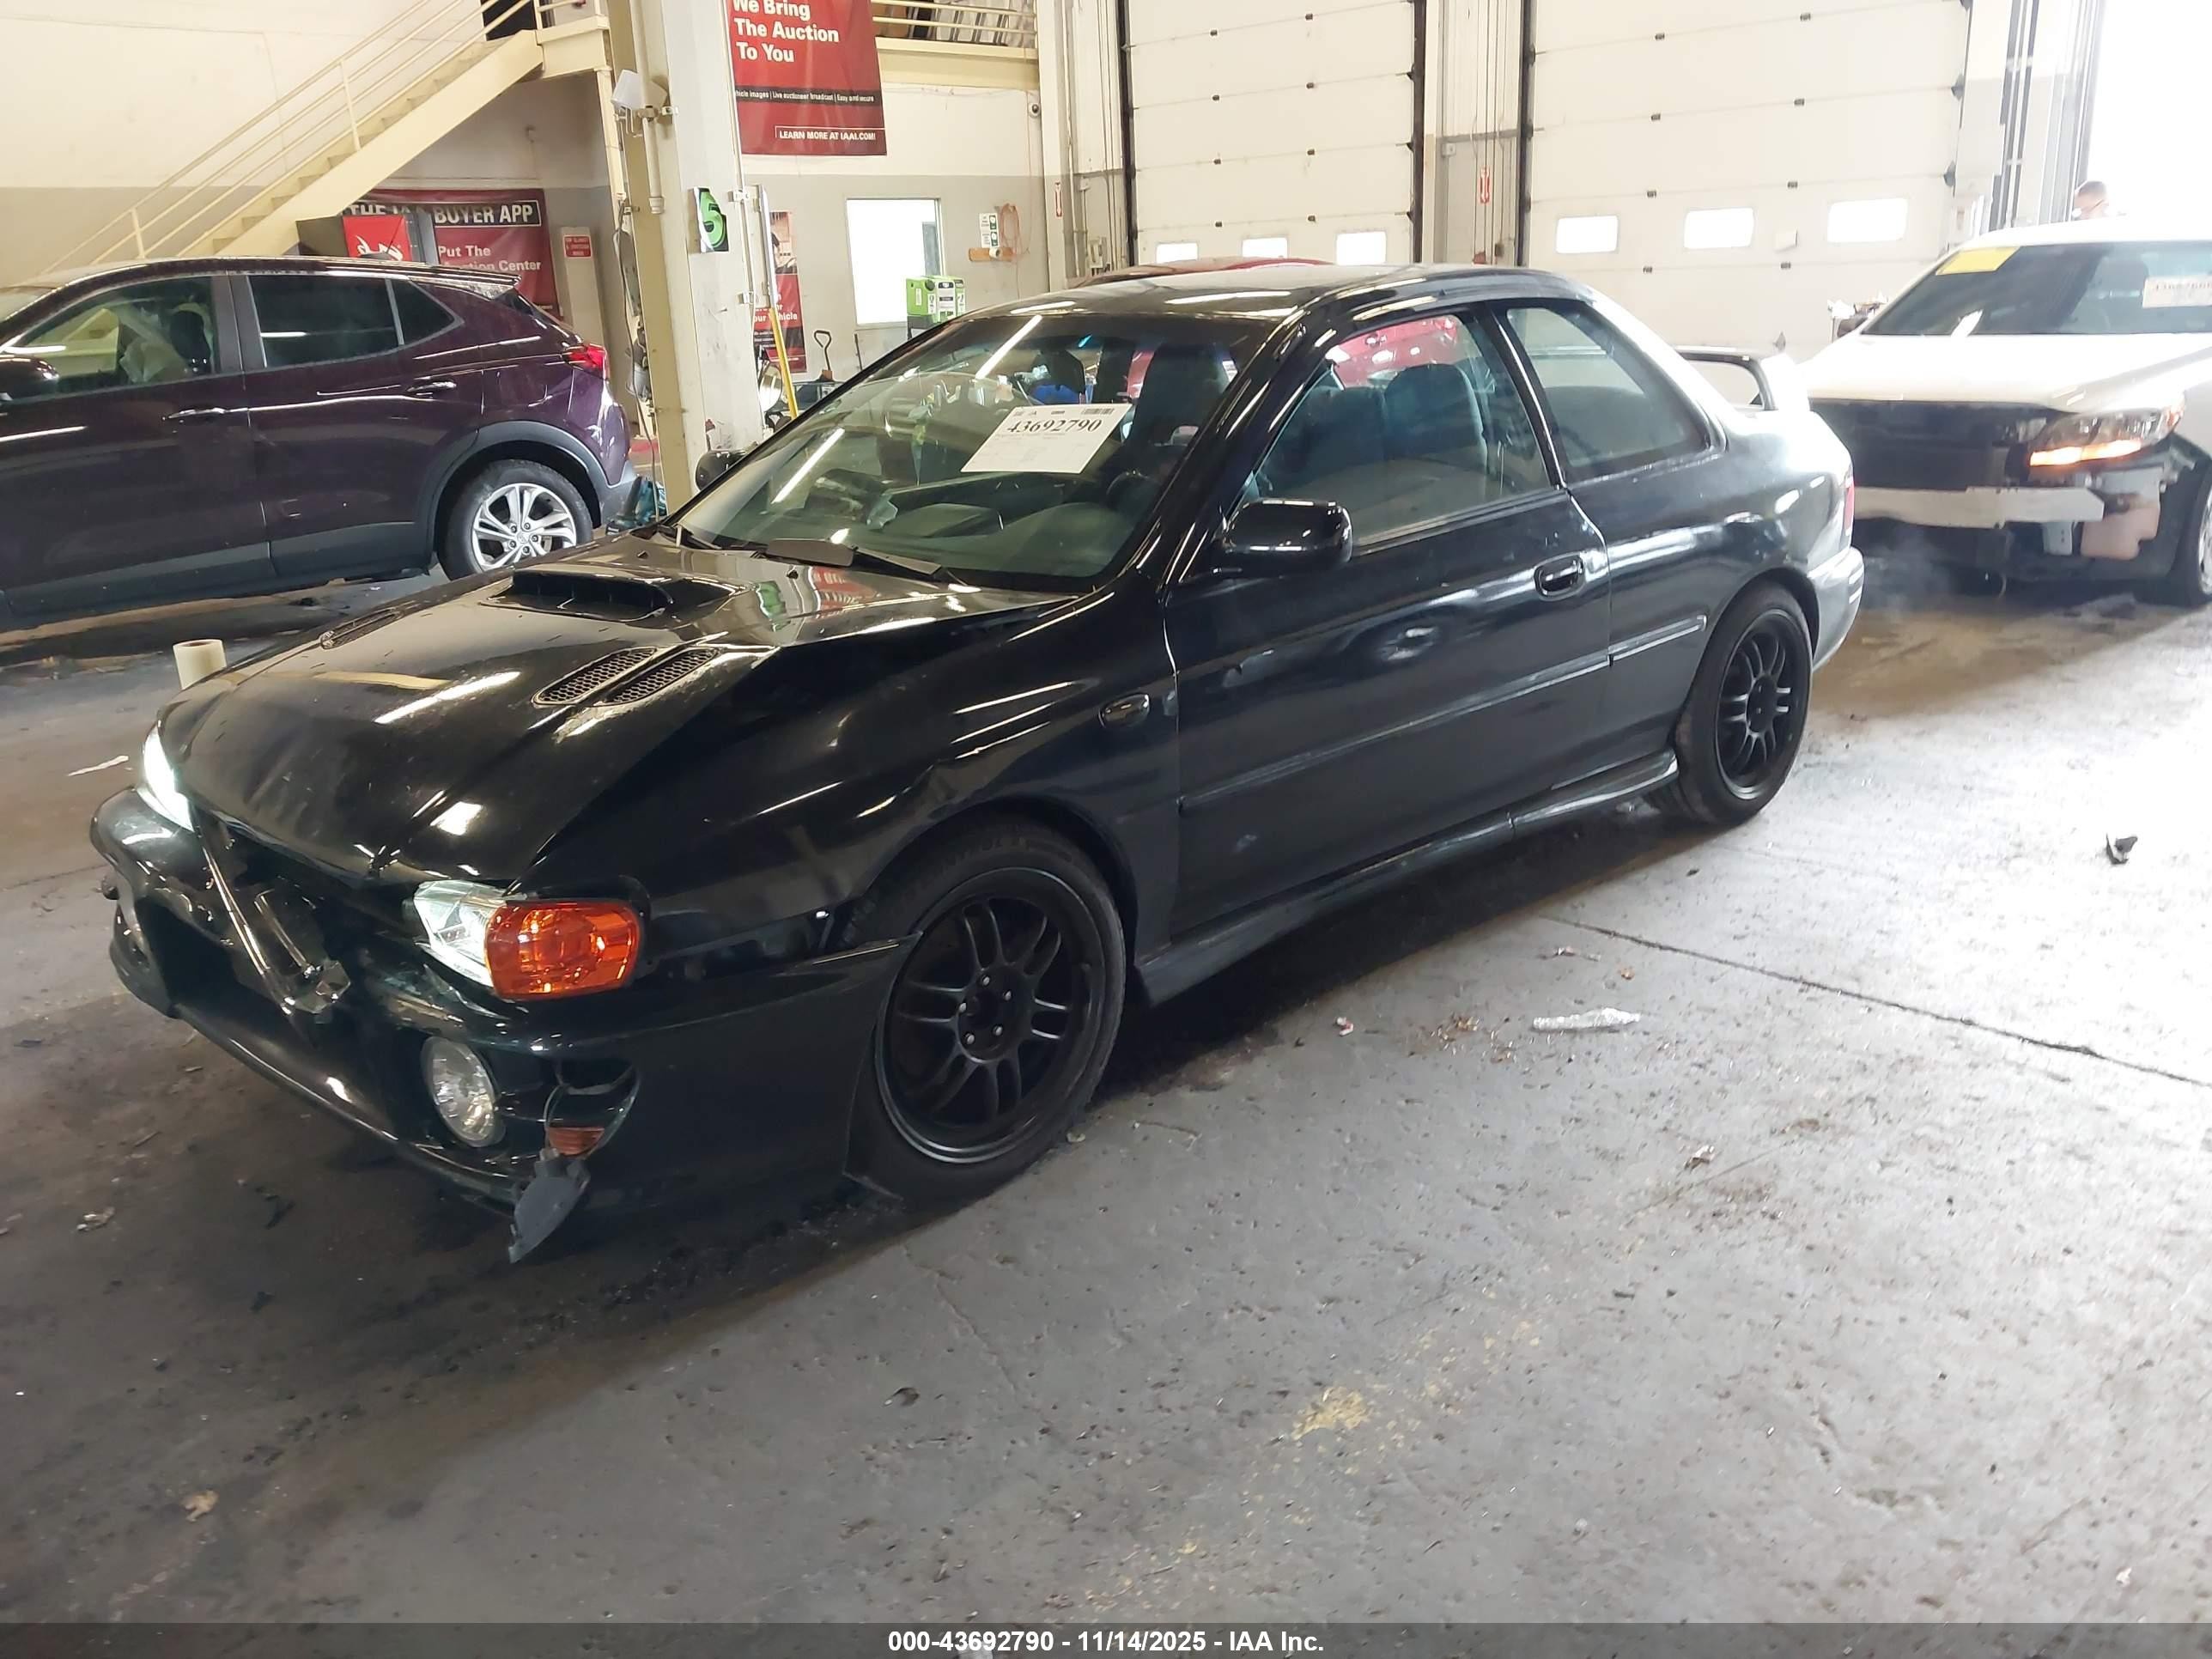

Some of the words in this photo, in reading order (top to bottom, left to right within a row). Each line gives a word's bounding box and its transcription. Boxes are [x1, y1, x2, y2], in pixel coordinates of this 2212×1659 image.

[732, 0, 760, 12] We
[764, 0, 811, 21] Bring
[734, 17, 768, 37] The
[773, 21, 840, 42] Auction
[736, 41, 757, 60] To
[762, 43, 795, 62] You
[779, 130, 805, 139] LEARN
[806, 131, 829, 140] MORE
[830, 131, 840, 140] AT
[434, 206, 495, 224] BUYER
[499, 204, 533, 223] APP
[437, 246, 462, 258] Put
[465, 245, 491, 257] The
[498, 259, 542, 272] Center
[1007, 419, 1103, 433] 43692790
